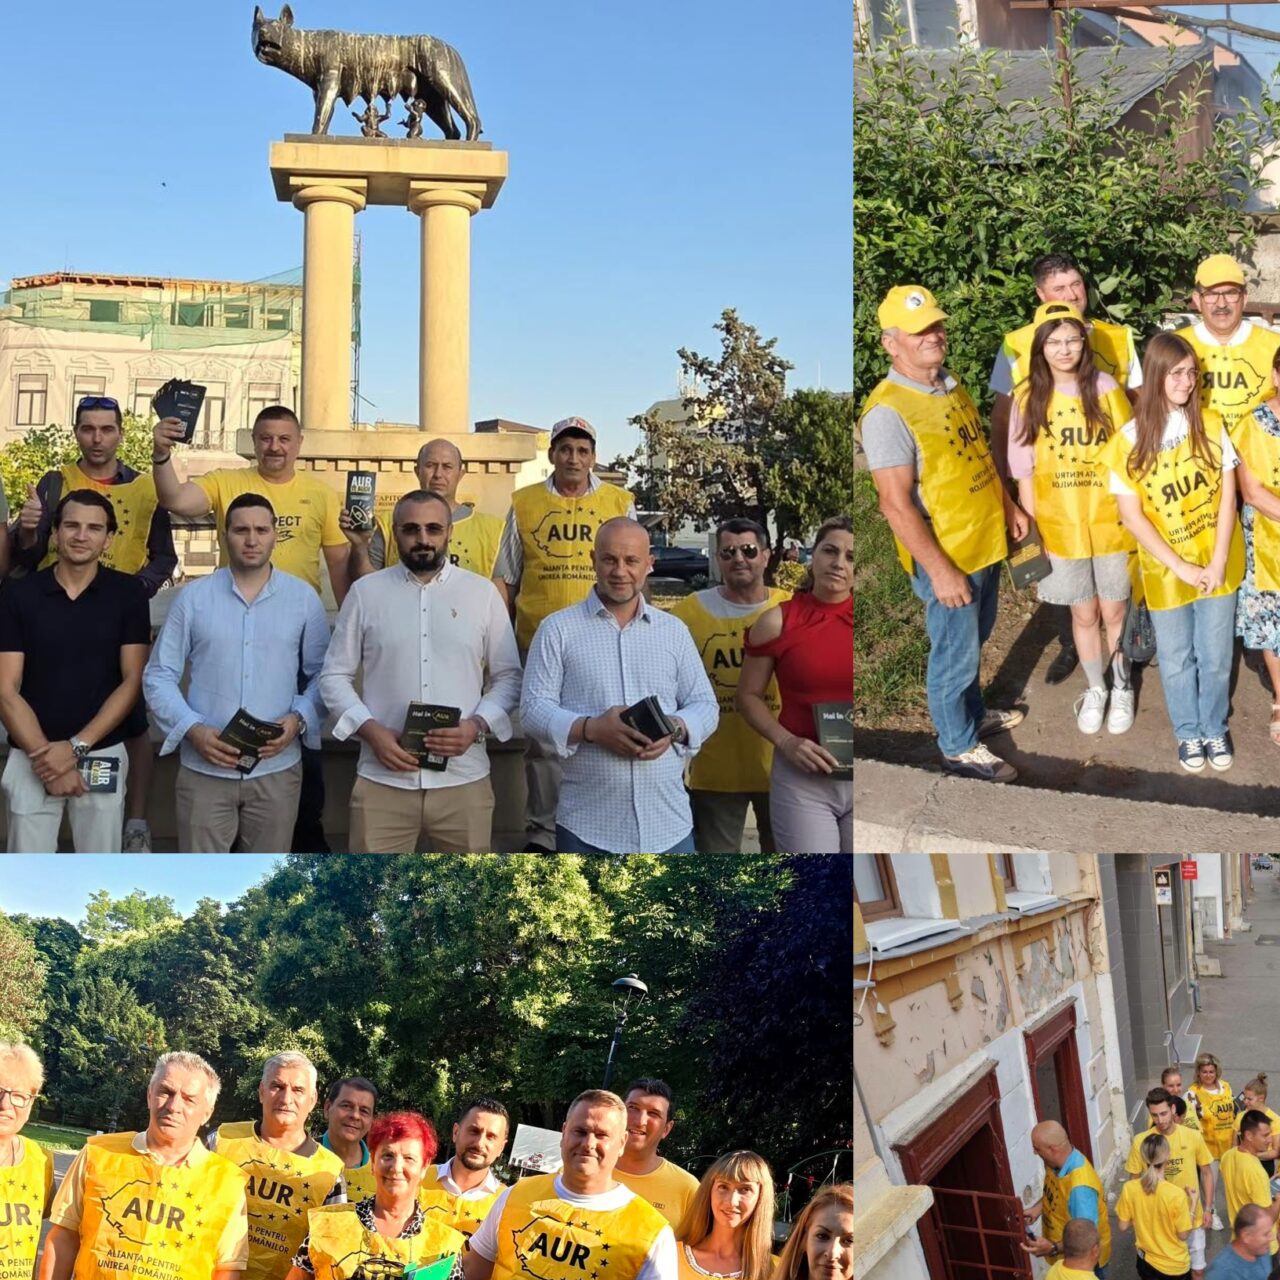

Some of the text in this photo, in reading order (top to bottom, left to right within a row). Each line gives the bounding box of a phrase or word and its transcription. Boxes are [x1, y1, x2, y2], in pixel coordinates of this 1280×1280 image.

[351, 476, 372, 487] AUR
[548, 524, 593, 542] AUR
[713, 648, 744, 668] AU
[99, 760, 112, 785] AUR
[0, 1203, 33, 1227] UR
[122, 1197, 185, 1232] AUR
[255, 1226, 287, 1242] PENTRU
[248, 1234, 290, 1255] OMÂNILOR
[528, 1232, 591, 1270] AUR
[97, 1259, 129, 1272] UNIREA
[147, 1256, 182, 1272] PENTRU
